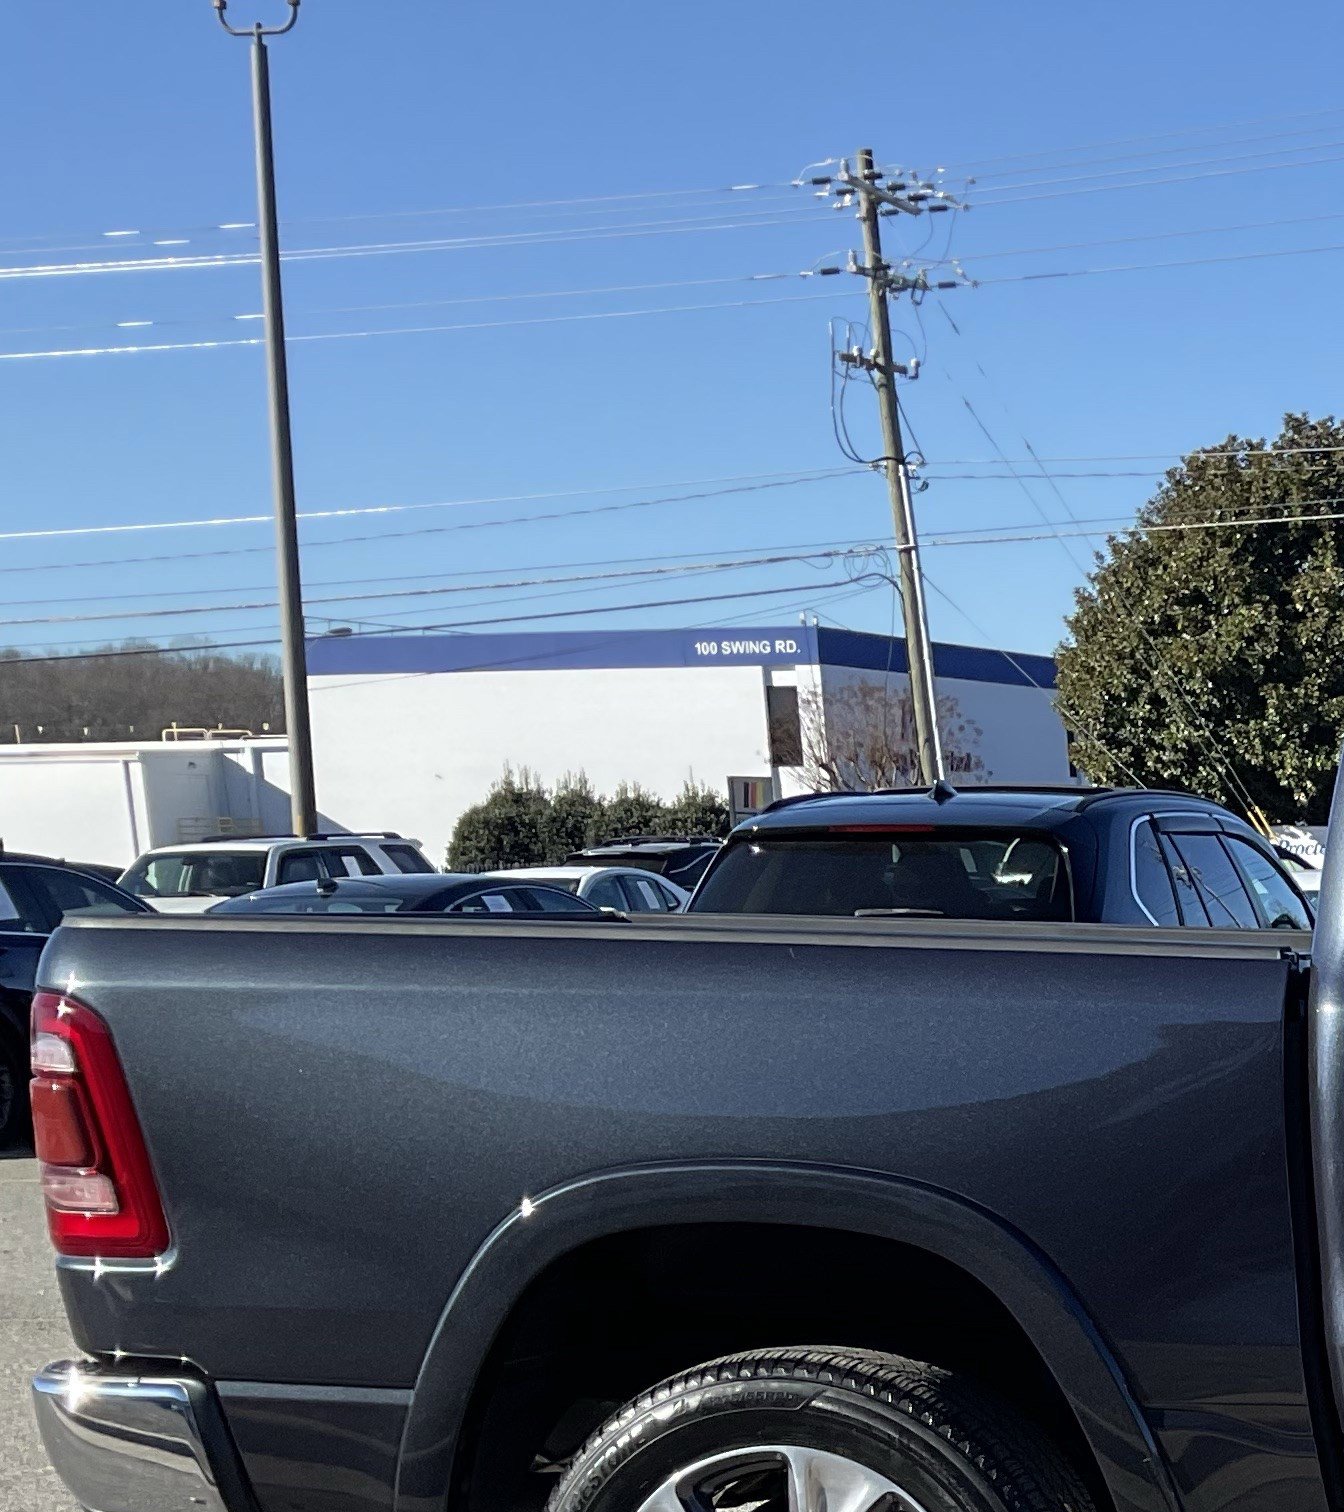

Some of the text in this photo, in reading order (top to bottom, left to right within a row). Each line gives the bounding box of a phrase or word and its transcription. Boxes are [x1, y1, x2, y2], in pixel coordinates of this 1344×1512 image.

[694, 639, 801, 655] 100 SWING RD.
